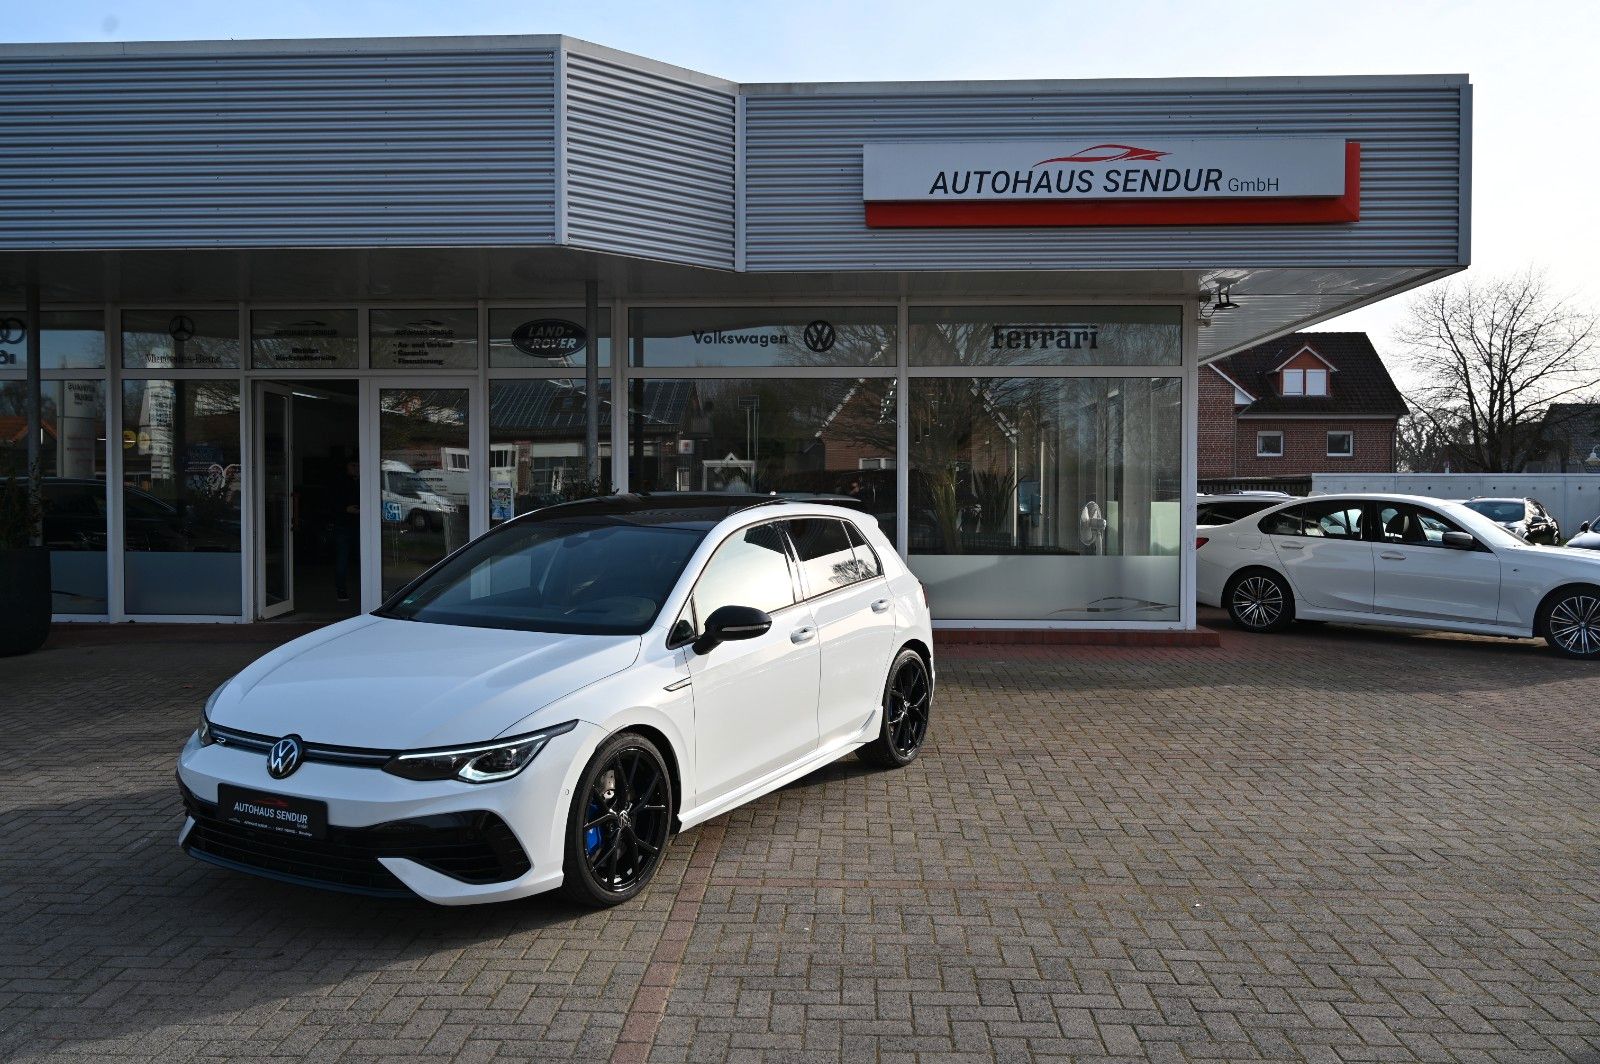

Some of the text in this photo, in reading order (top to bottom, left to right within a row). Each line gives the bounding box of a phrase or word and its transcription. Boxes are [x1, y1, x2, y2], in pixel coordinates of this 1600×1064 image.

[929, 168, 1280, 195] AUTOHAUS SENDUR GmbH
[528, 326, 565, 337] LAND
[692, 330, 788, 347] Volkswagen
[991, 325, 1098, 349] Ferrari
[531, 338, 577, 349] ROVER
[233, 801, 308, 824] AUTOHAUS SENDUR
